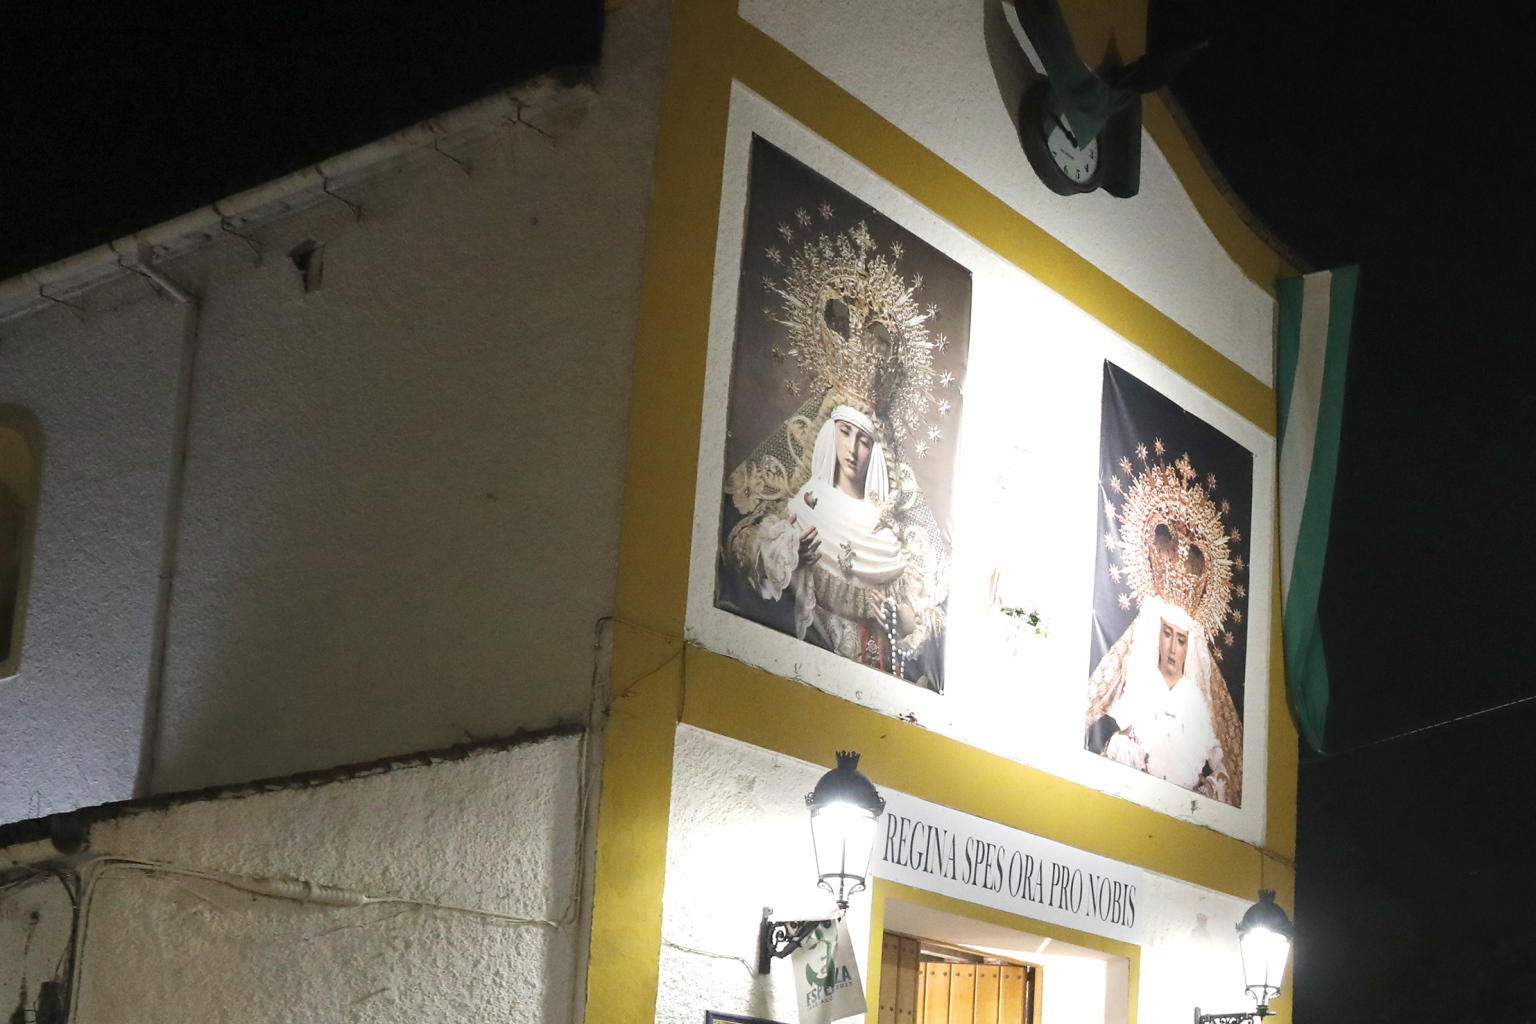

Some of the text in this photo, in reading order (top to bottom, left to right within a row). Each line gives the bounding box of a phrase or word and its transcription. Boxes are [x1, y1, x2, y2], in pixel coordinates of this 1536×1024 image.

[882, 812, 1137, 929] REGINA SPES ORA PRO NOBIS
